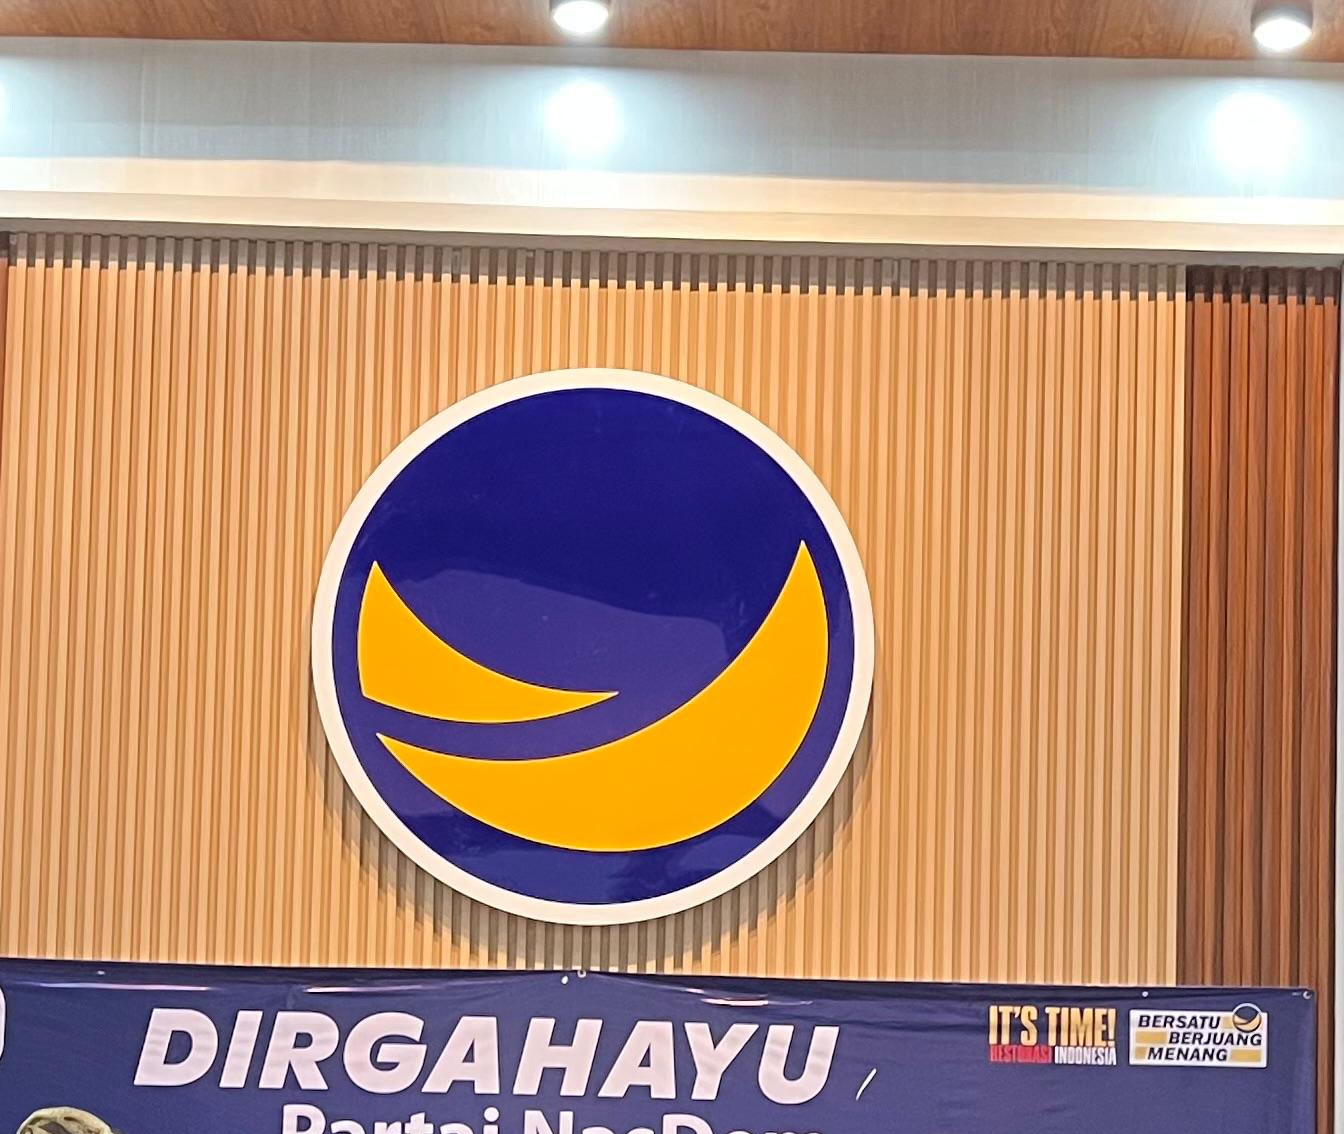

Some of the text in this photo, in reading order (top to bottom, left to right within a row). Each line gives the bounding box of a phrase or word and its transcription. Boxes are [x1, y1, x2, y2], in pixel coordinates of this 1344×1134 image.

[989, 1005, 1117, 1047] IT'S TIME!
[1137, 1014, 1221, 1029] BERSATU
[1167, 1031, 1263, 1046] BERJUANG
[134, 1007, 840, 1104] DIRGAHAYU
[1054, 1046, 1117, 1066] INDONESIA
[1147, 1047, 1228, 1062] MENANG
